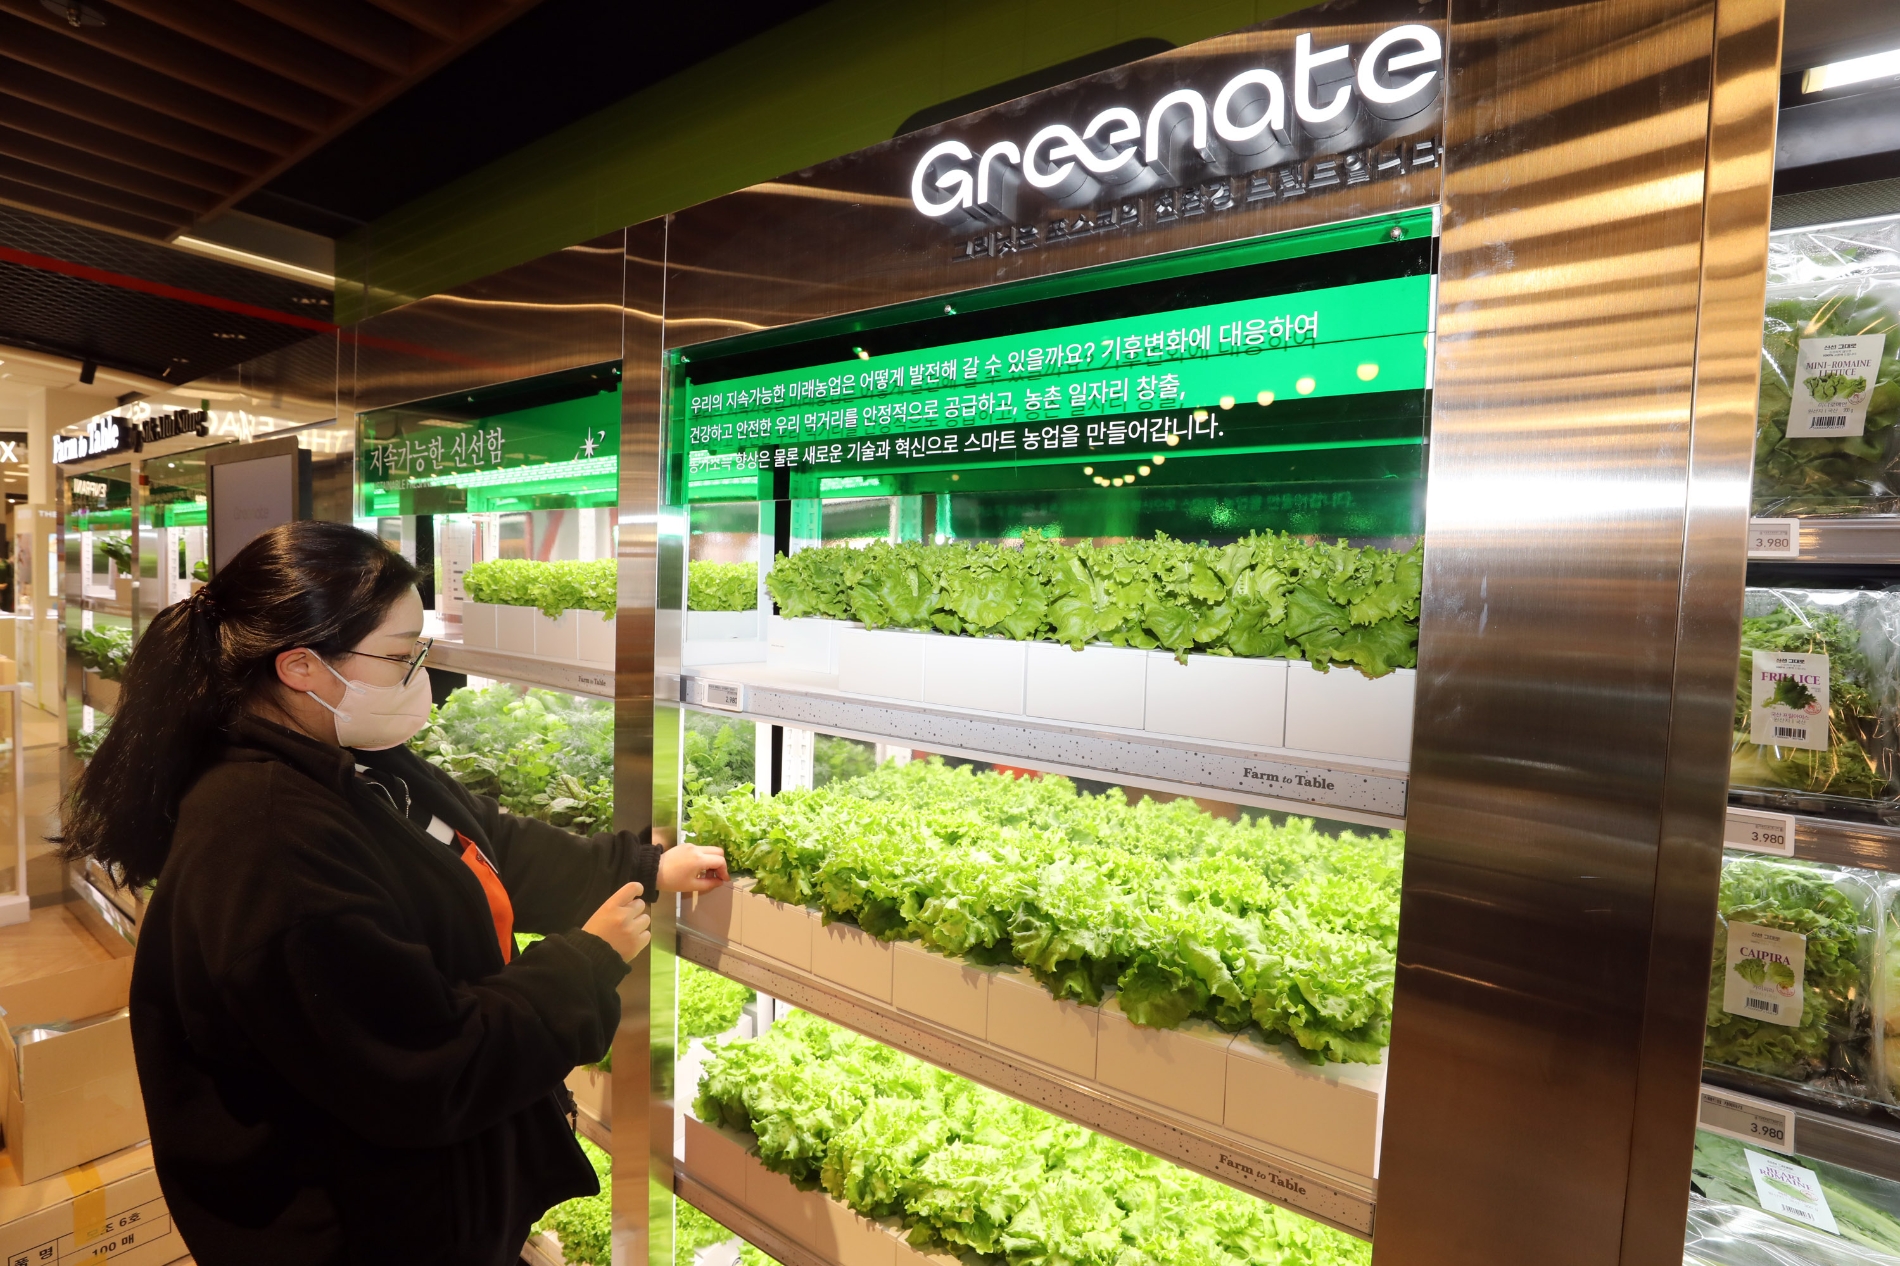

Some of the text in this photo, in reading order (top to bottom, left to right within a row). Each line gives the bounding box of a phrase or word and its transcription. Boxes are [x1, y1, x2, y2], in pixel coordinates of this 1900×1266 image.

[911, 24, 1442, 217] Greenate
[690, 311, 1318, 414] 우리의 지속가능한 미래농업은 어떻게 발전해 갈 수 있을까요? 기후변화에 대응하여
[1806, 359, 1872, 370] MINI-ROMAINE
[690, 372, 1186, 444] 건강하고 안전한 우리 먹거리를 안정적으로 공급하고, 농촌 일자리 창출,
[52, 434, 78, 464] Farm
[78, 434, 88, 458] to
[87, 415, 119, 455] Table
[735, 449, 771, 470] 향상은
[773, 447, 798, 468] 물론
[803, 443, 843, 465] 새로운
[847, 438, 891, 461] 기술과
[895, 433, 959, 458] 혁신으로
[963, 429, 1017, 453] 스마트
[1022, 425, 1080, 450] 농업을
[1086, 413, 1225, 445] 만들어갑니다.
[369, 427, 506, 477] 지속가능한 신선함
[1243, 767, 1335, 791] Farm to Table
[1739, 946, 1791, 966] CAIPIRA
[1219, 1153, 1307, 1196] Farm to Table
[1759, 1168, 1814, 1191] ROMAINE
[1766, 1166, 1802, 1182] HEART
[119, 1212, 141, 1228] 6호
[39, 1245, 53, 1260] 명
[92, 1233, 135, 1257] 100 매
